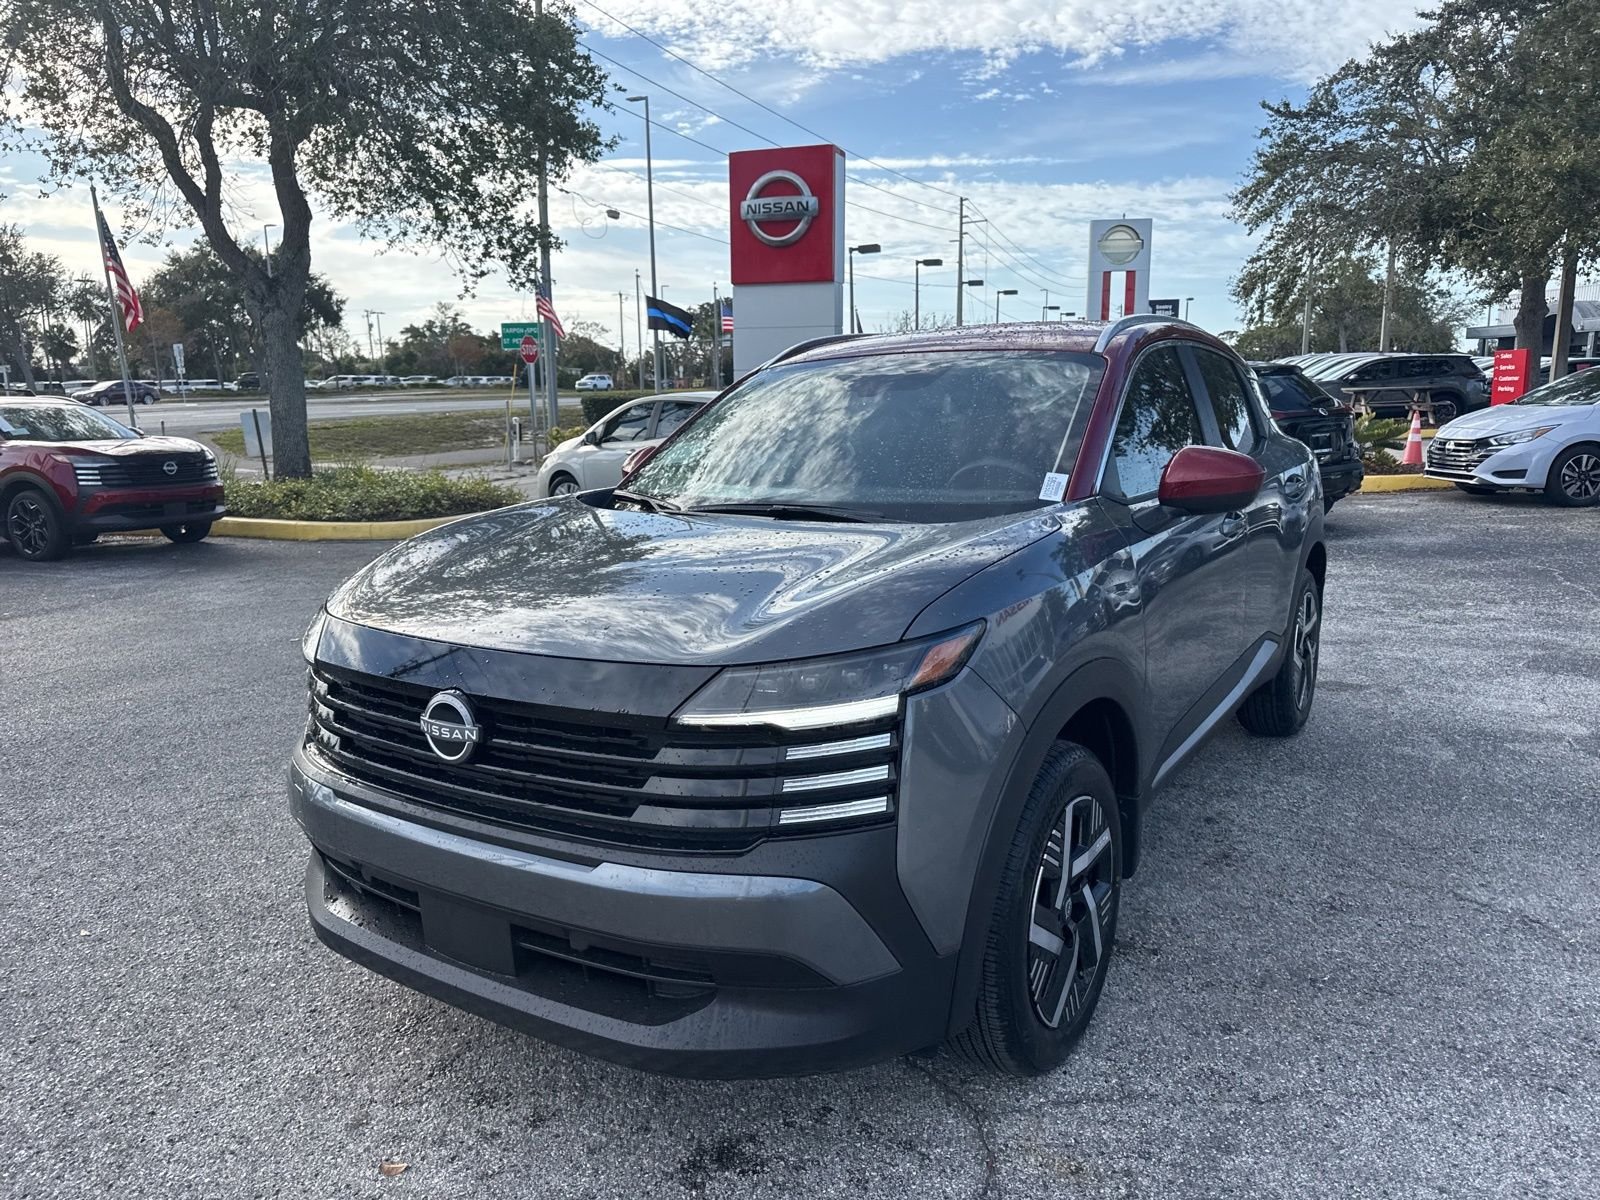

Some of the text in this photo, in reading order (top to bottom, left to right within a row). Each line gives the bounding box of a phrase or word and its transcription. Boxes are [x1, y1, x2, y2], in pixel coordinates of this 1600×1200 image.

[746, 201, 809, 215] NISSAN
[522, 344, 537, 355] STOP
[420, 719, 476, 740] NISSAN
